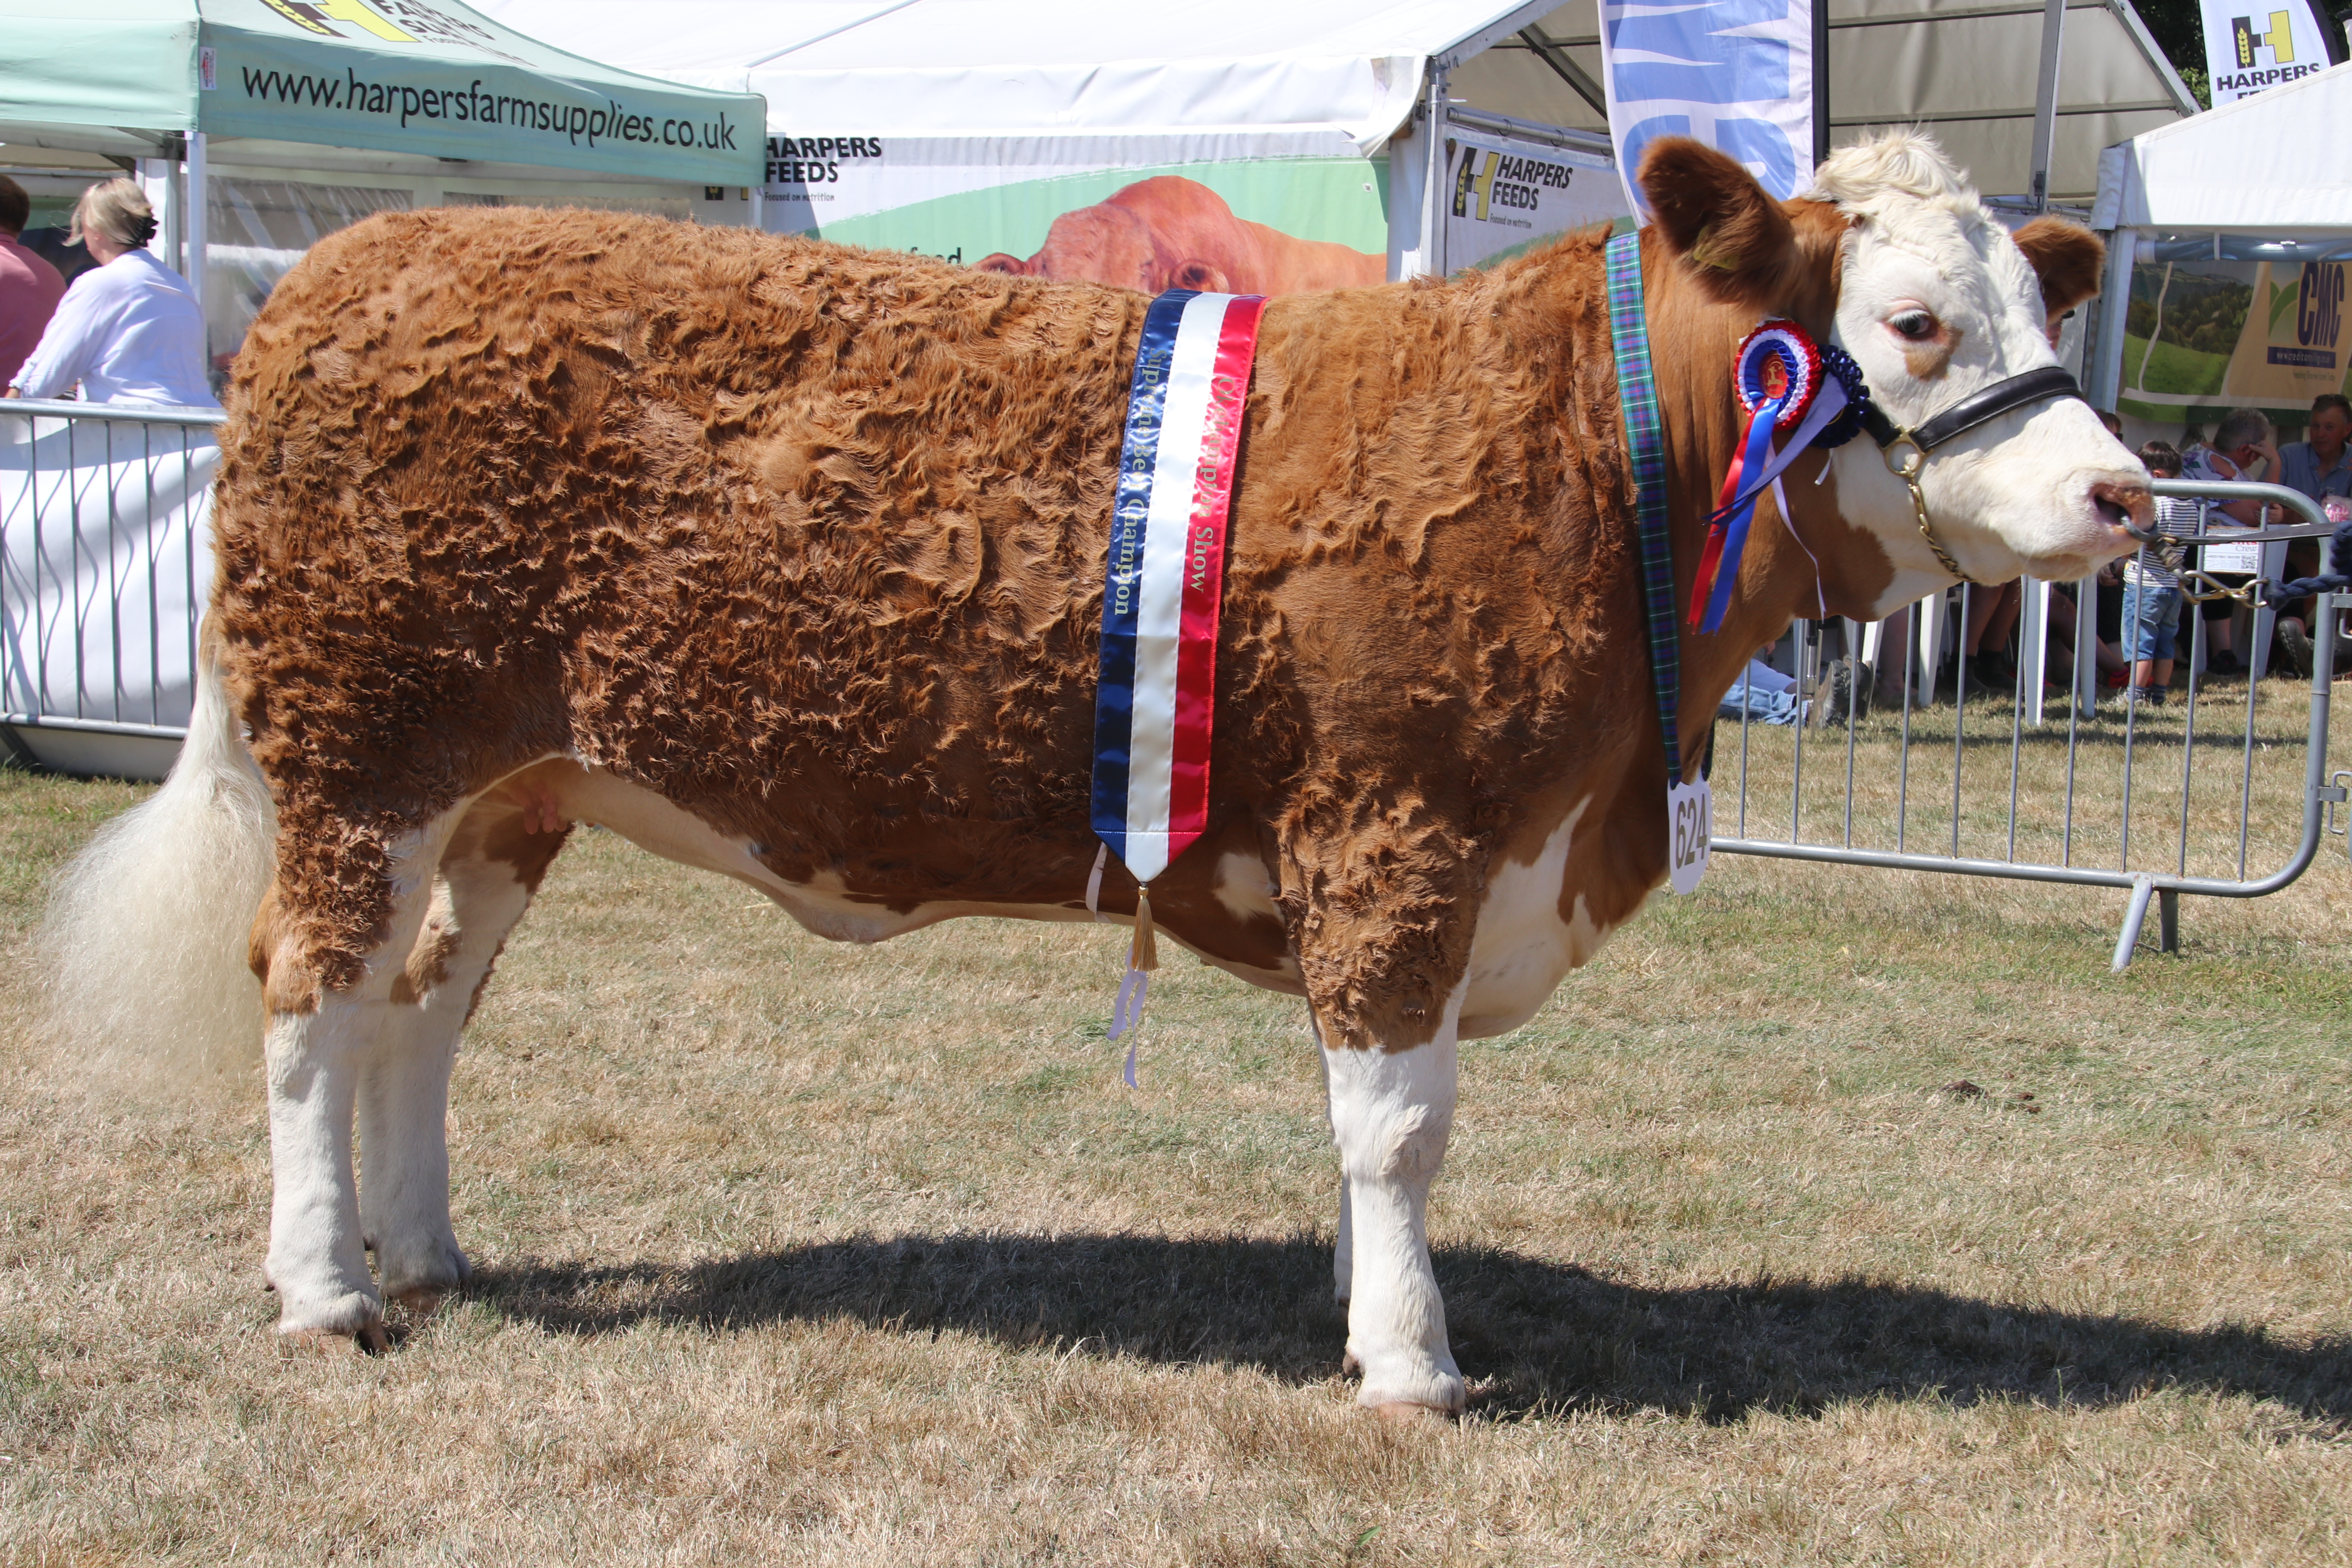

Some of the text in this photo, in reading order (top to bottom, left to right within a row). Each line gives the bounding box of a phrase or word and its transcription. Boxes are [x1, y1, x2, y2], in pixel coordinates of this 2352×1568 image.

[2216, 63, 2321, 91] HARPERS
[242, 67, 737, 149] www.harpersfarmsupplies.co.uk
[766, 137, 882, 158] HARPERS
[766, 161, 838, 183] FEEDS
[1497, 155, 1573, 189] HARPERS
[765, 192, 789, 201] Focused
[802, 192, 835, 201] nutrition
[1492, 181, 1539, 211] FEEDS
[2298, 262, 2345, 348] CMC
[1138, 348, 1167, 437] Supreme
[1191, 377, 1236, 594] Okehampton Show
[1114, 499, 1145, 616] Champion
[1675, 794, 1708, 869] 624
